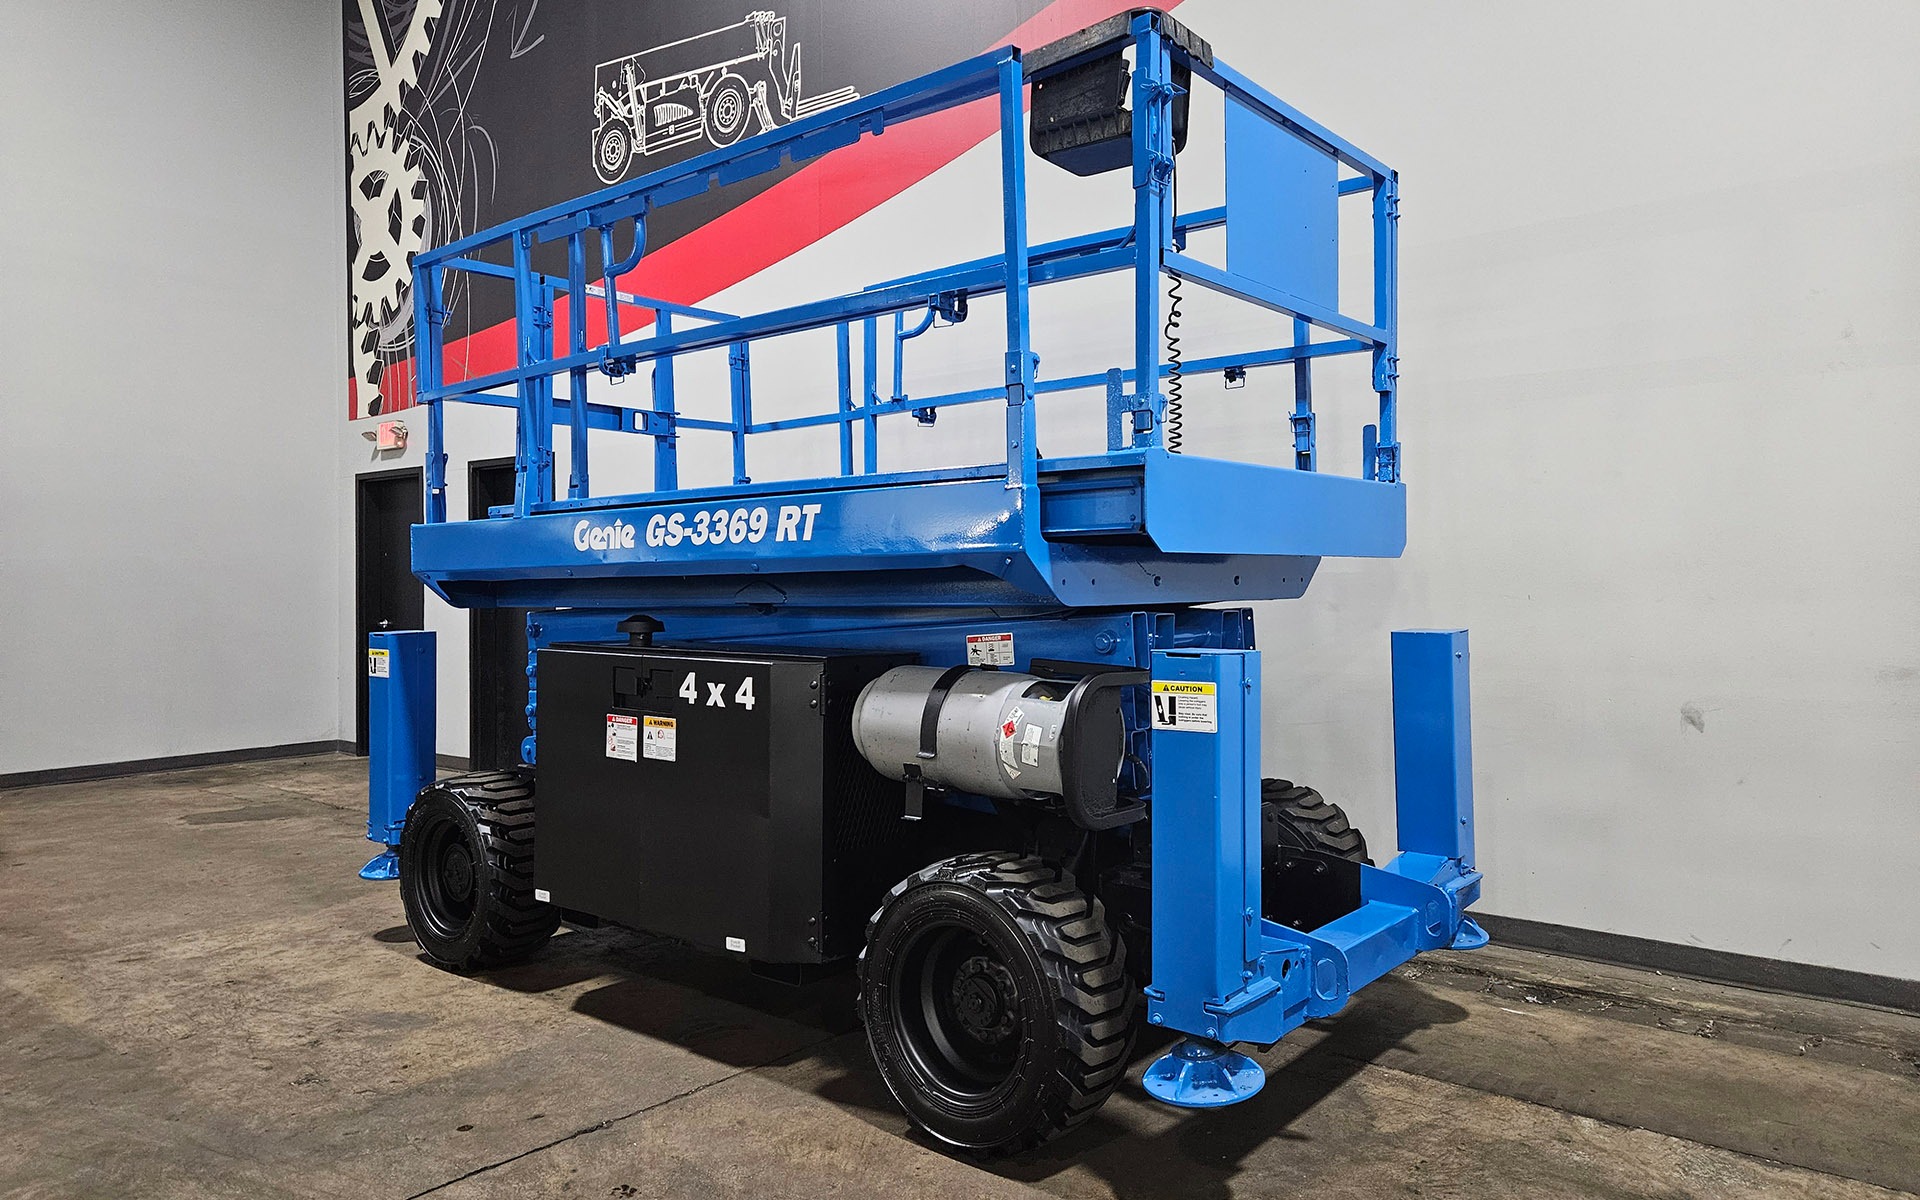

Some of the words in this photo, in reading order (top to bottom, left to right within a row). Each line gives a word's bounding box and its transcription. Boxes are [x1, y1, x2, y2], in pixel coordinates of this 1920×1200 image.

[573, 518, 635, 551] Genie
[645, 507, 768, 547] GS-3369
[775, 504, 821, 542] RT
[679, 672, 697, 704] 4
[706, 682, 726, 708] x
[735, 677, 755, 710] 4
[616, 716, 632, 724] DANGER
[653, 719, 673, 728] WARNING
